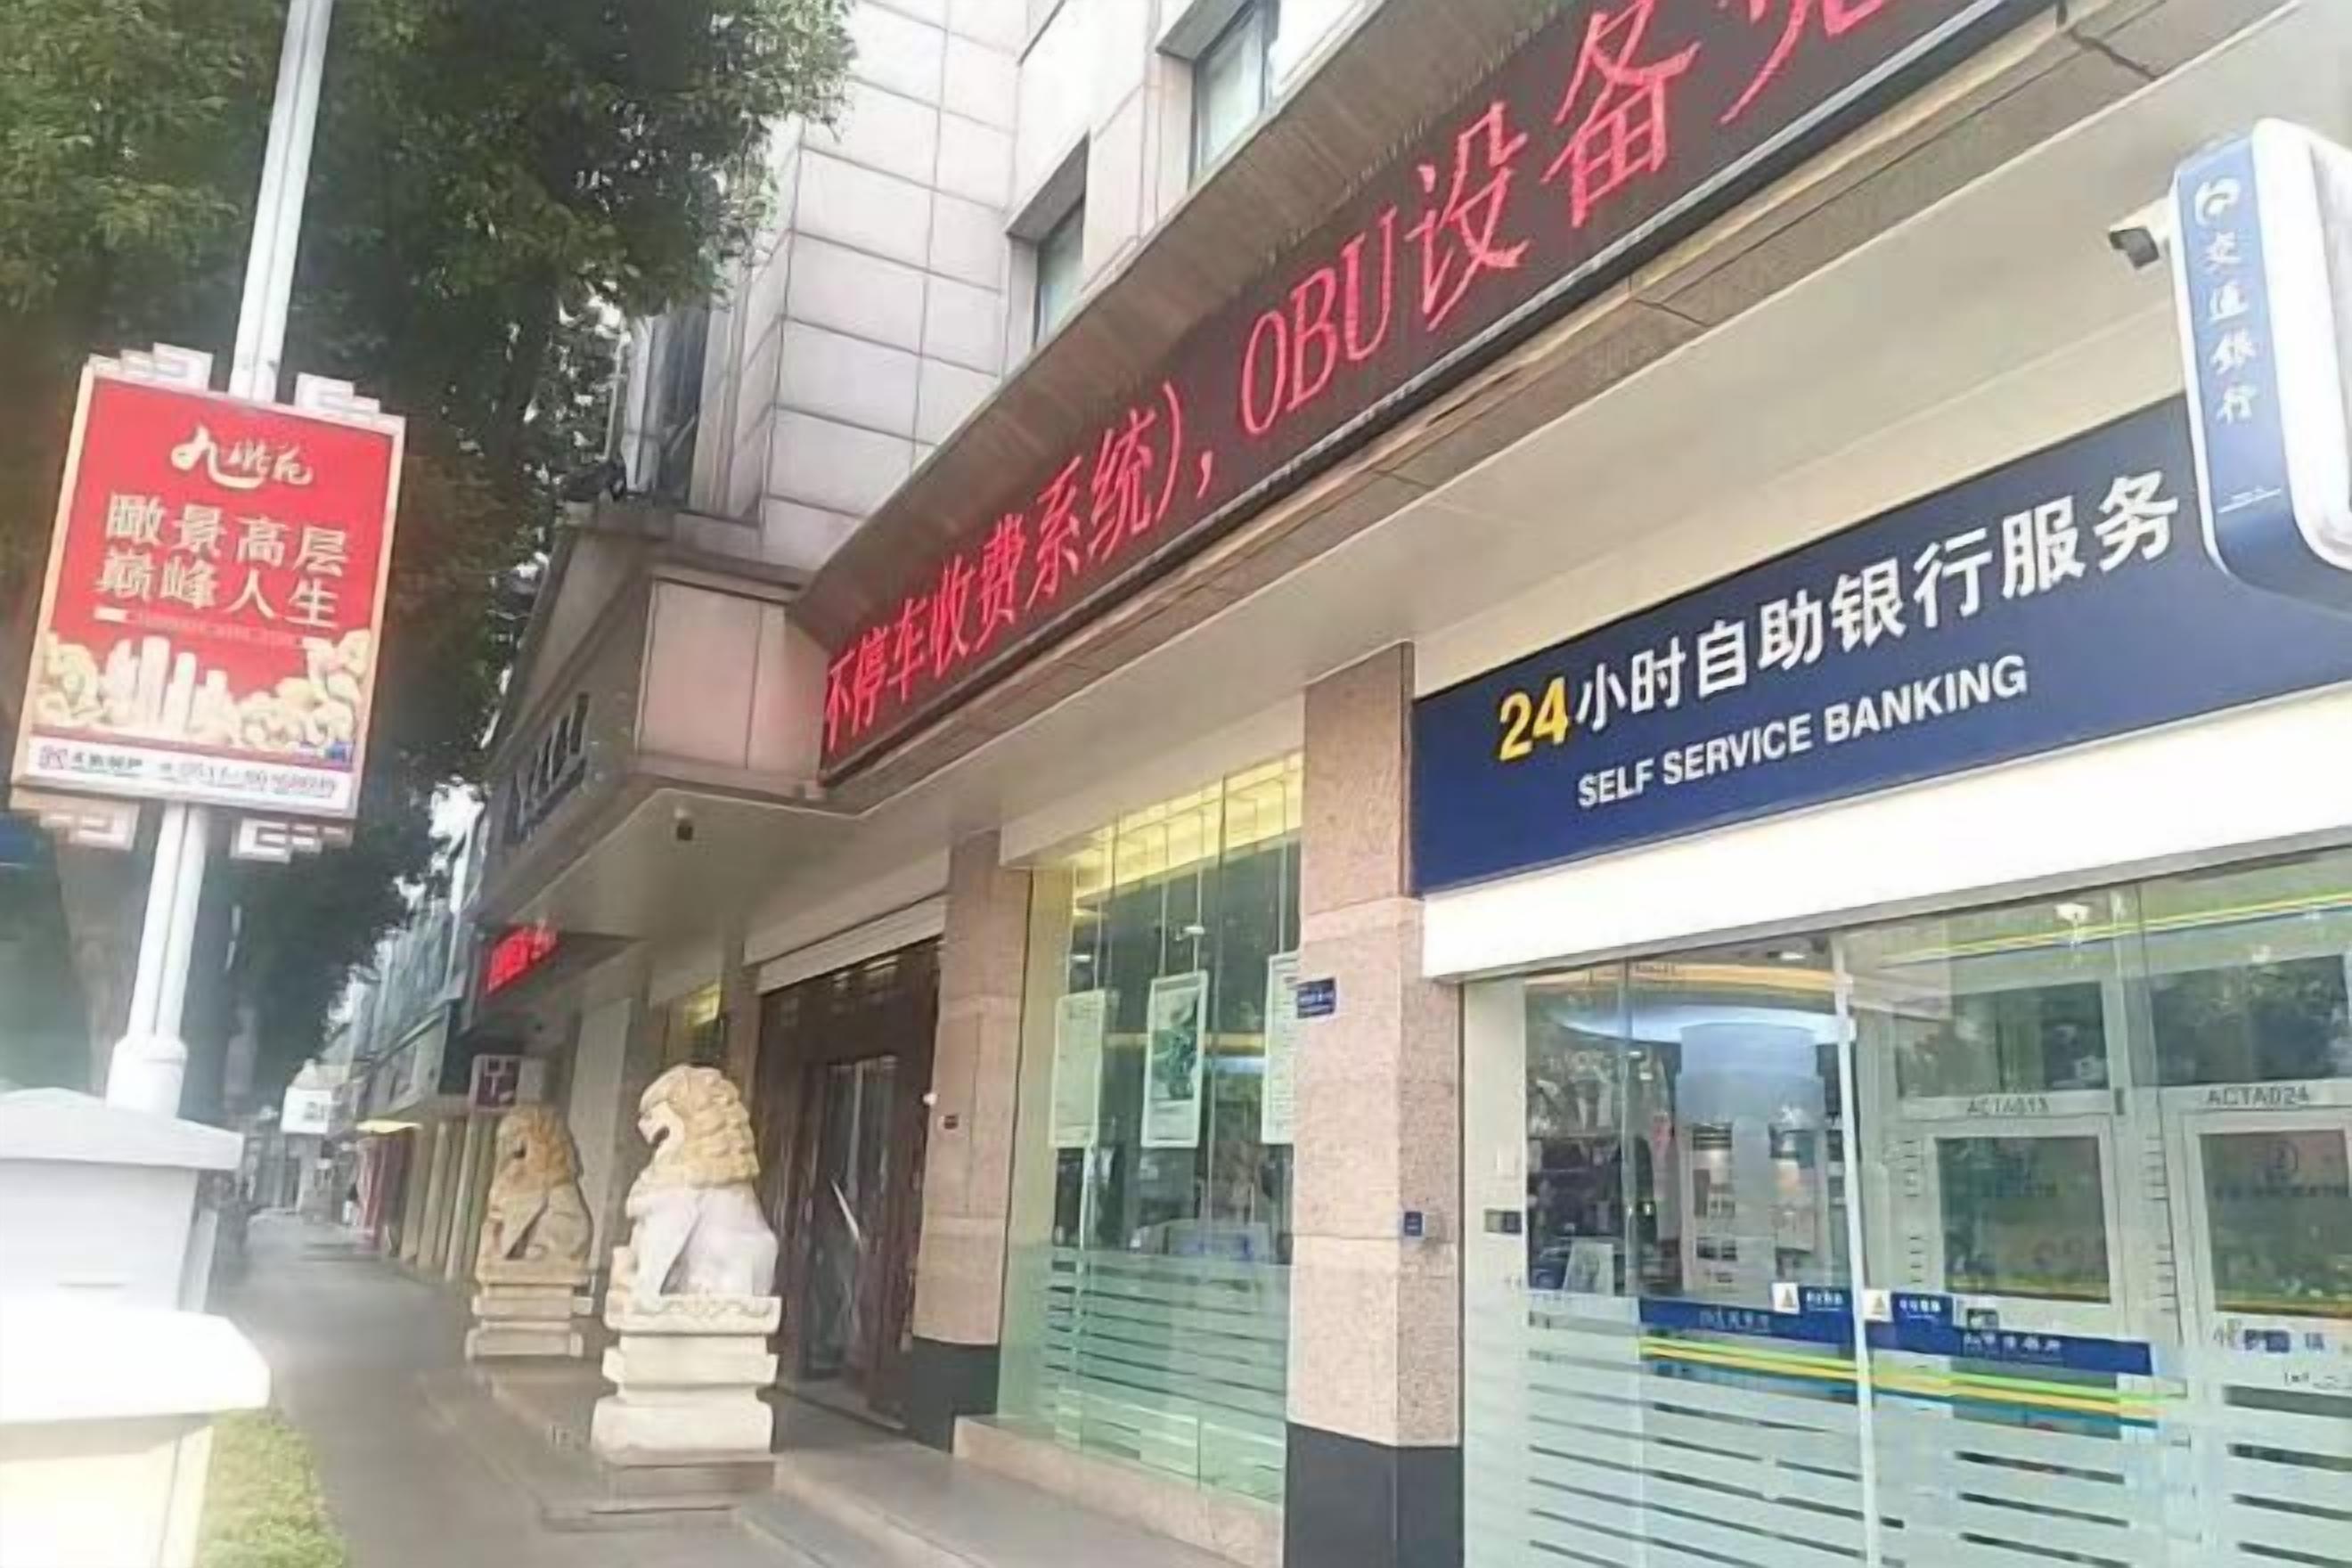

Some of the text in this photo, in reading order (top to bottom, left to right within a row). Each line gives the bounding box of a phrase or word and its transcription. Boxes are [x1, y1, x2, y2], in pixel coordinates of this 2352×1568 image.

[95, 547, 339, 630] 巅峰人生
[105, 492, 350, 578] 瞰景高层
[1498, 470, 2179, 763] 24小时自助银行服务
[1577, 654, 2028, 810] SELF SERVICE BANKING
